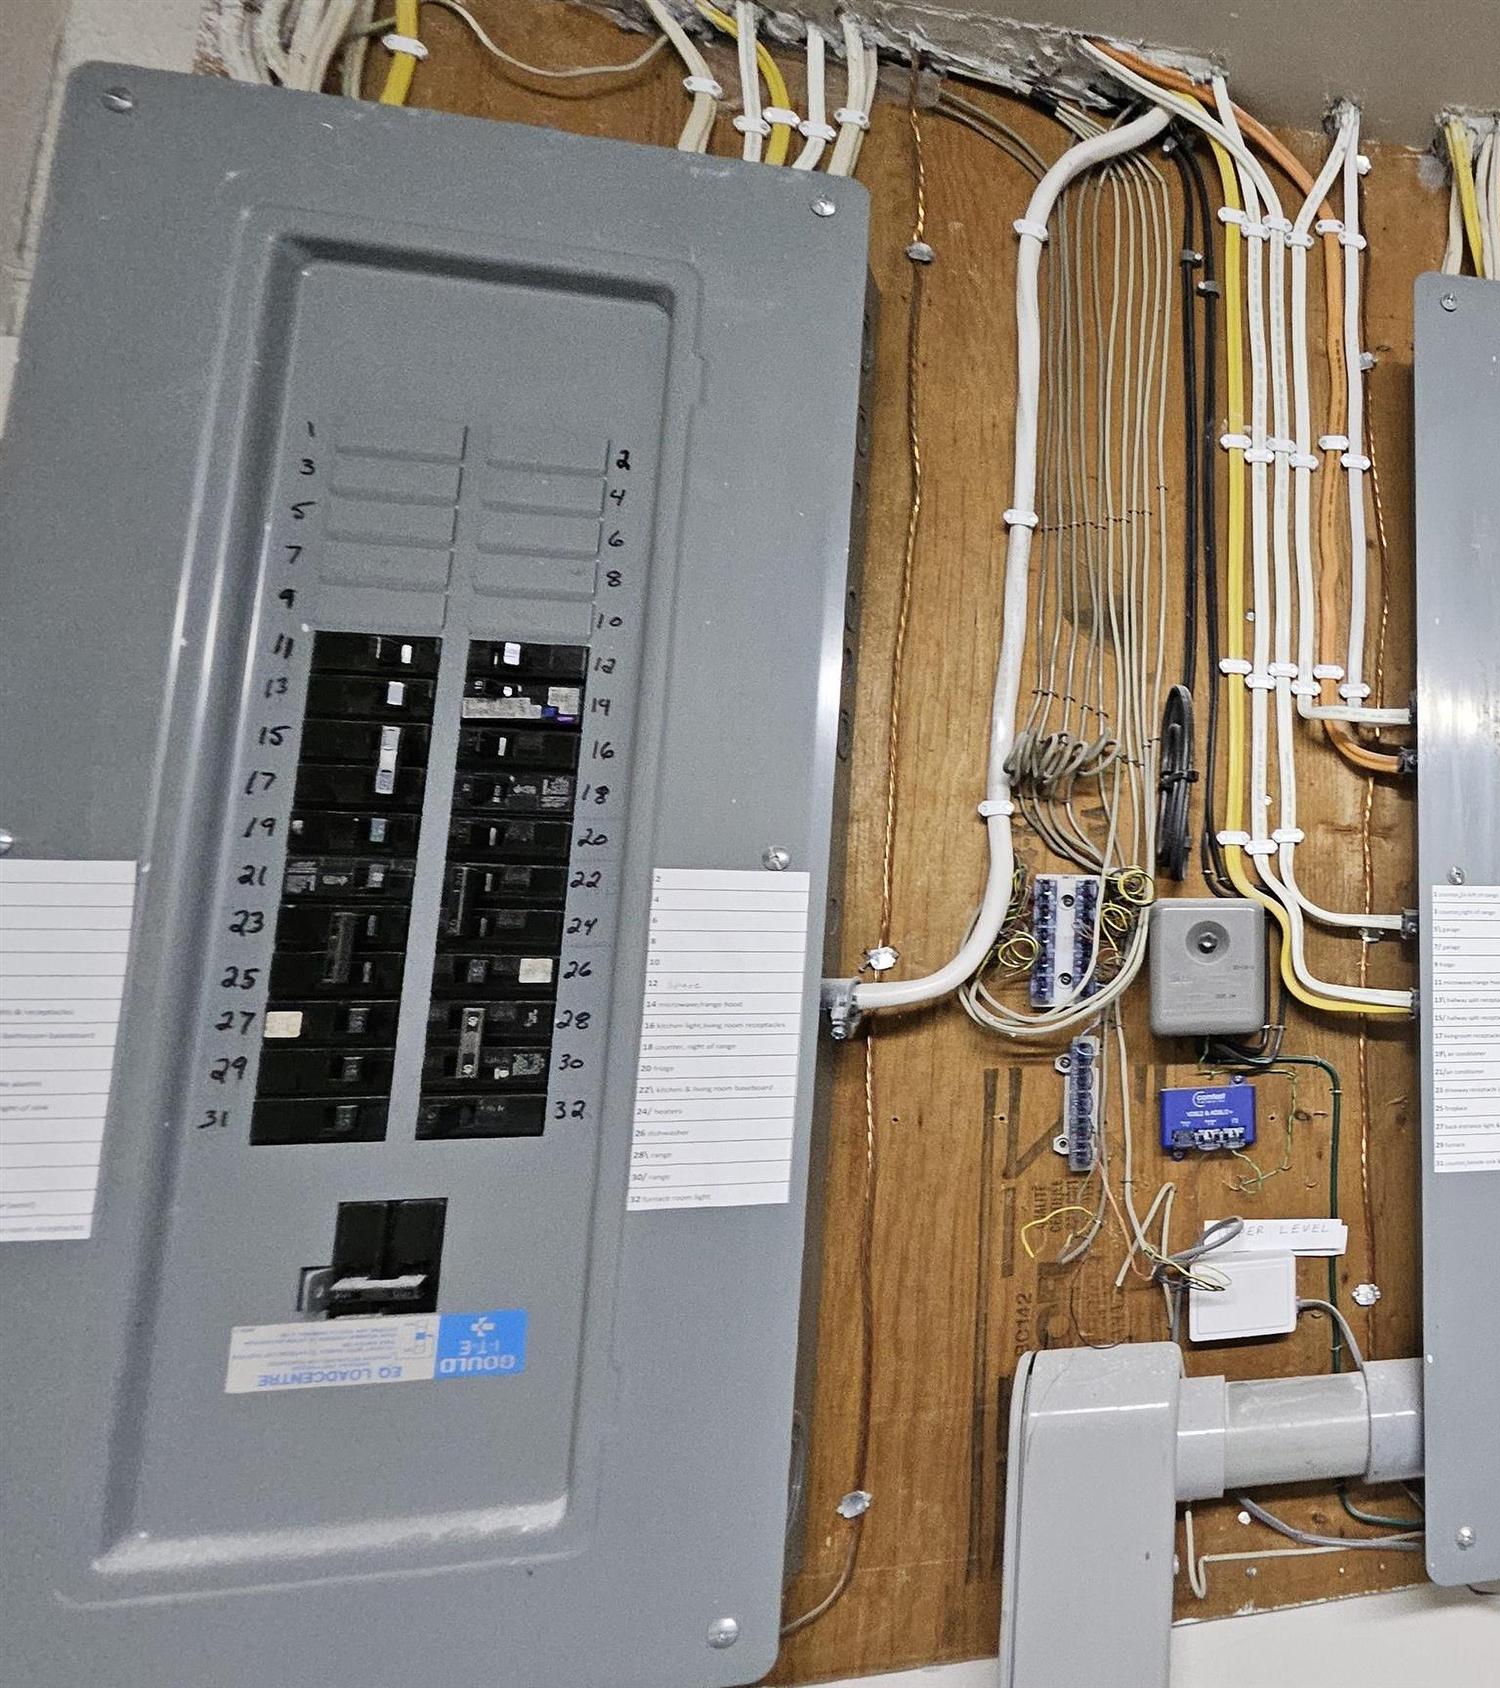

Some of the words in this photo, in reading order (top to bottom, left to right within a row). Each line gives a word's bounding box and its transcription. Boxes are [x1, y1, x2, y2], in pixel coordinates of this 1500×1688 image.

[308, 421, 315, 437] 1
[300, 459, 316, 475] 3
[617, 451, 631, 470] 2
[610, 489, 626, 506] 4
[291, 502, 315, 519] 5
[608, 530, 624, 547] 6
[284, 546, 302, 563] 7
[606, 570, 622, 587] 8
[279, 589, 296, 608] 9
[597, 613, 622, 630] 10
[274, 636, 293, 656] 11
[594, 657, 616, 674] 12
[266, 678, 288, 697] 13
[258, 727, 291, 746] 15
[592, 741, 614, 760] 16
[245, 772, 275, 793] 17
[583, 784, 609, 805] 18
[244, 818, 275, 838] 19
[578, 828, 608, 846] 20
[237, 865, 267, 886] 21
[571, 871, 602, 889] 22
[229, 910, 264, 933] 23
[567, 917, 598, 936] 24
[221, 966, 260, 989] 25
[562, 960, 592, 979] 26
[215, 1011, 256, 1033] 27
[555, 1009, 591, 1030] 28
[209, 1057, 249, 1081] 29
[558, 1054, 585, 1071] 30
[197, 1109, 229, 1128] 31
[554, 1100, 586, 1120] 32
[1279, 1223, 1330, 1235] LEVEL
[379, 1365, 403, 1378] EQ
[440, 1354, 516, 1374] GOULD
[257, 1366, 373, 1387] LOADCENTRE
